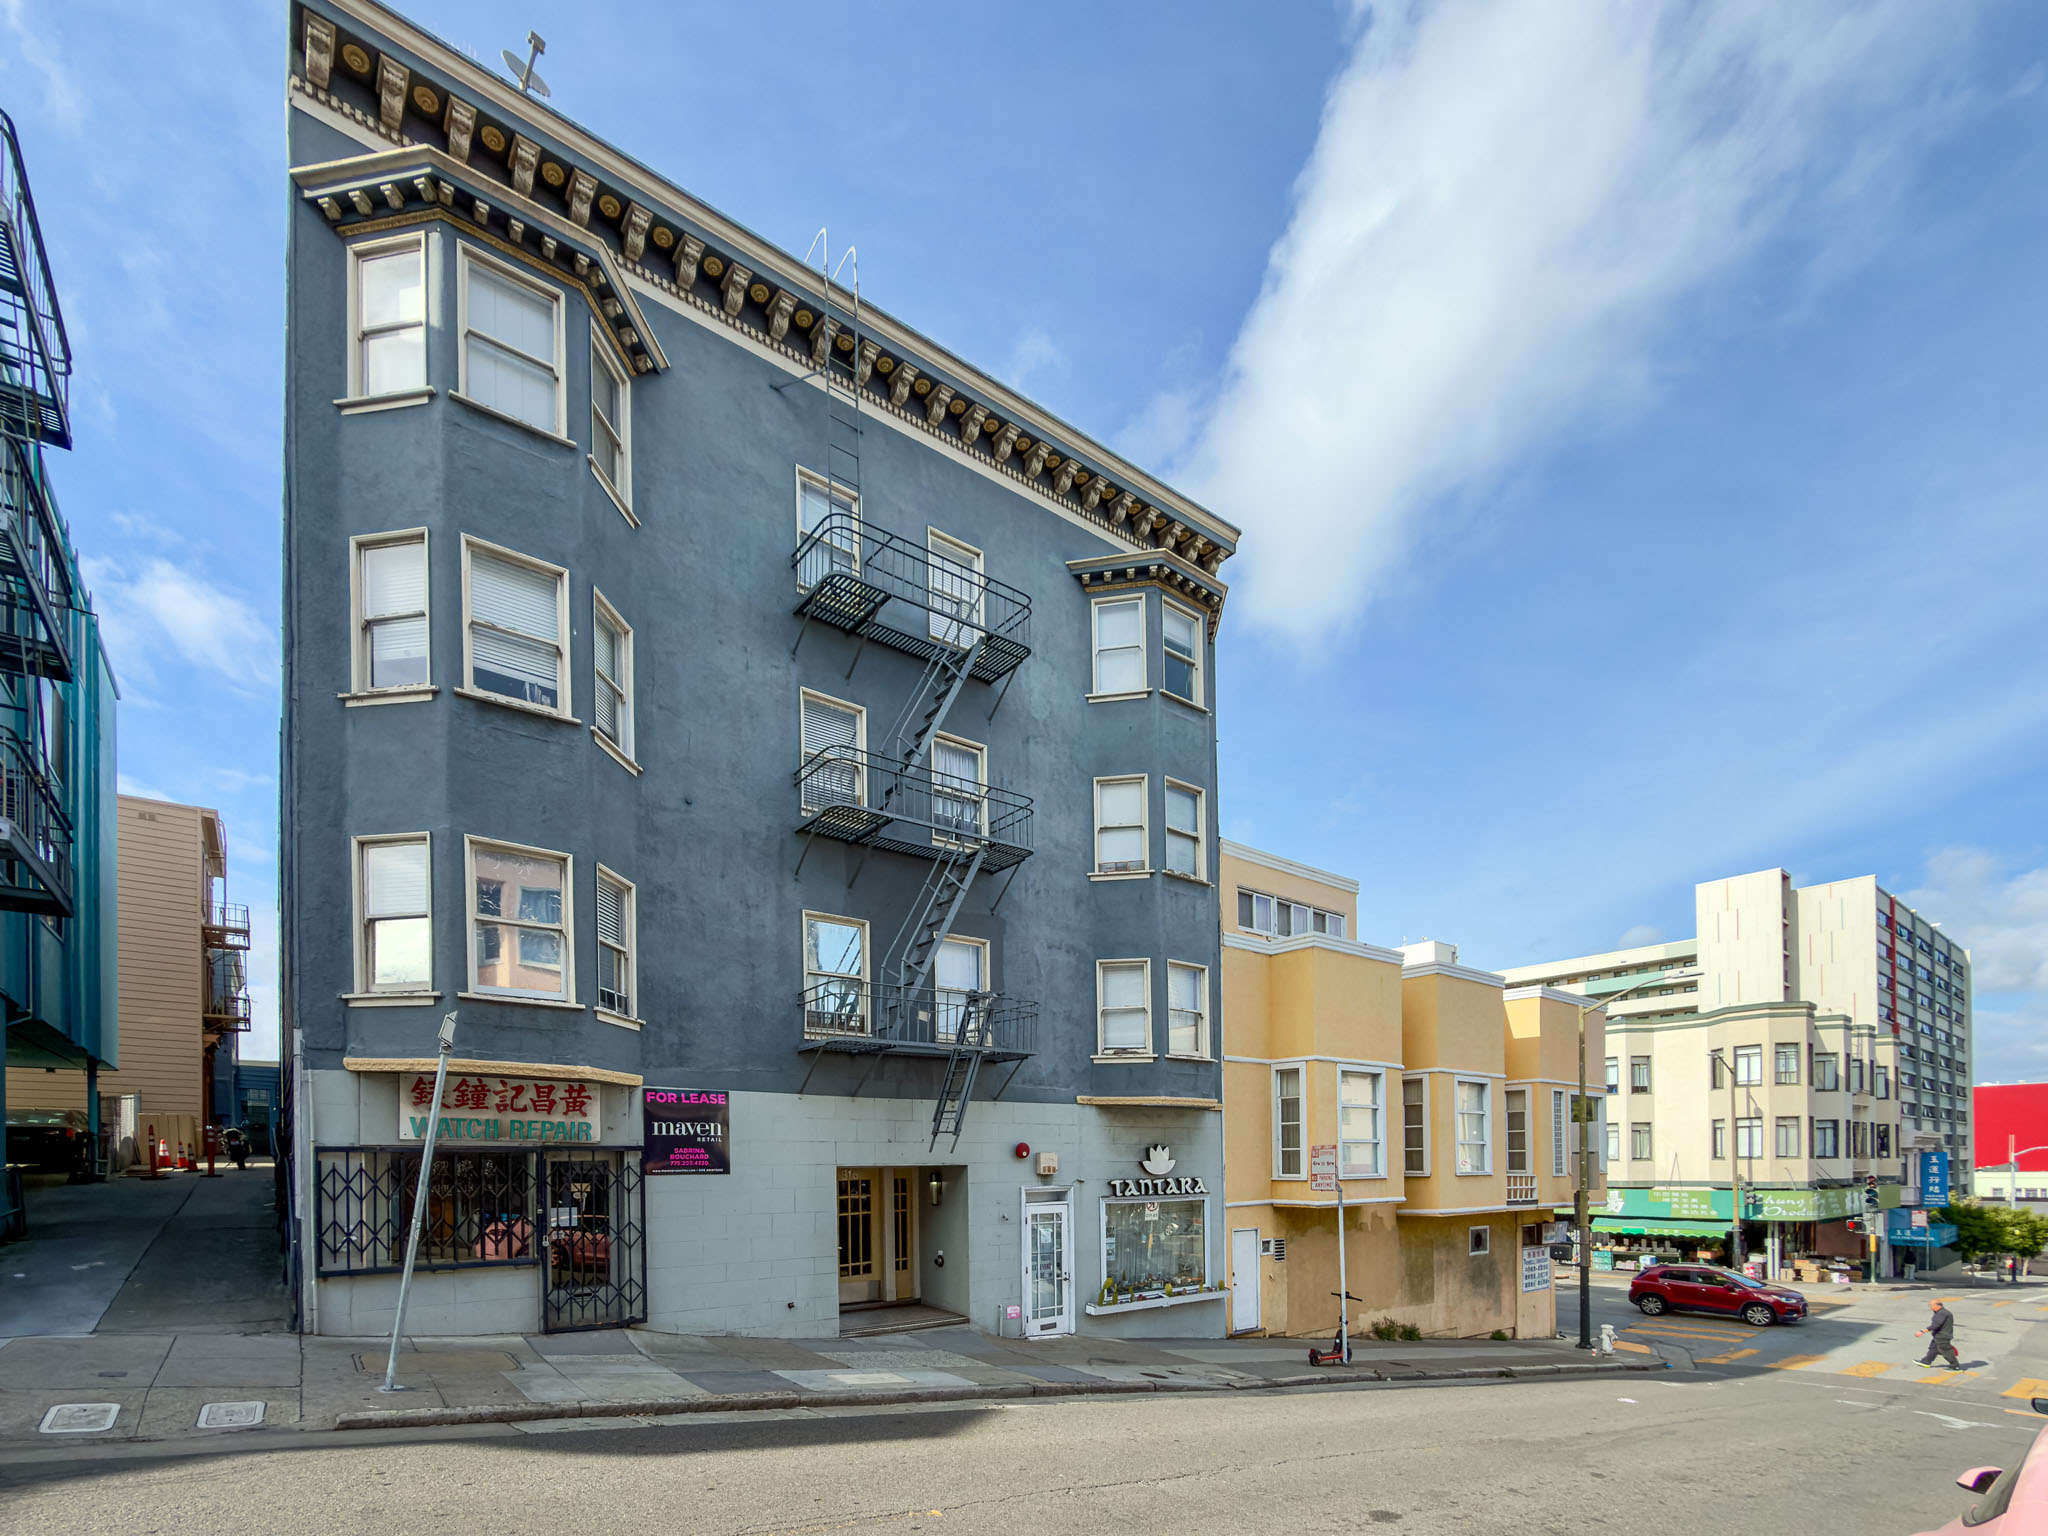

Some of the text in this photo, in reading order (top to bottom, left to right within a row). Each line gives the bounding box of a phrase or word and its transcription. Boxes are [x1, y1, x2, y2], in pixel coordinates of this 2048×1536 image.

[646, 1091, 726, 1105] FOR LEASE
[409, 1116, 592, 1141] WATCH REPAIR
[652, 1121, 723, 1136] maven
